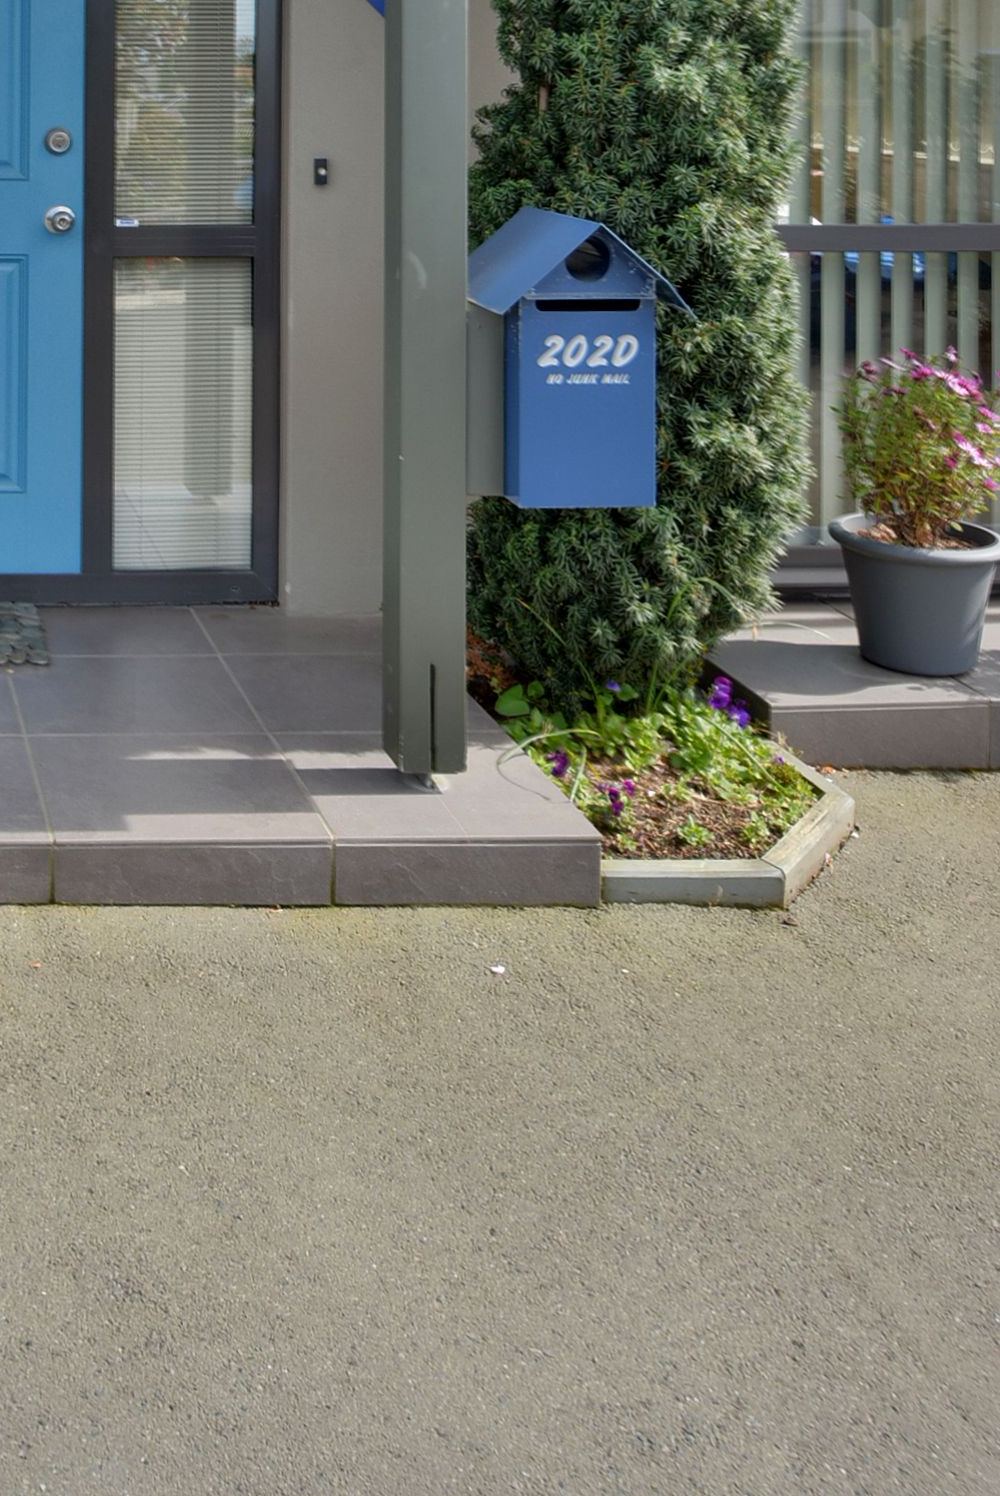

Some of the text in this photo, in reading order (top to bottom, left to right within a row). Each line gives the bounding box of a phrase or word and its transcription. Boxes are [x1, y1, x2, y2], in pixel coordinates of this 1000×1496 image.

[546, 373, 630, 385] NO JUNK MAIL
